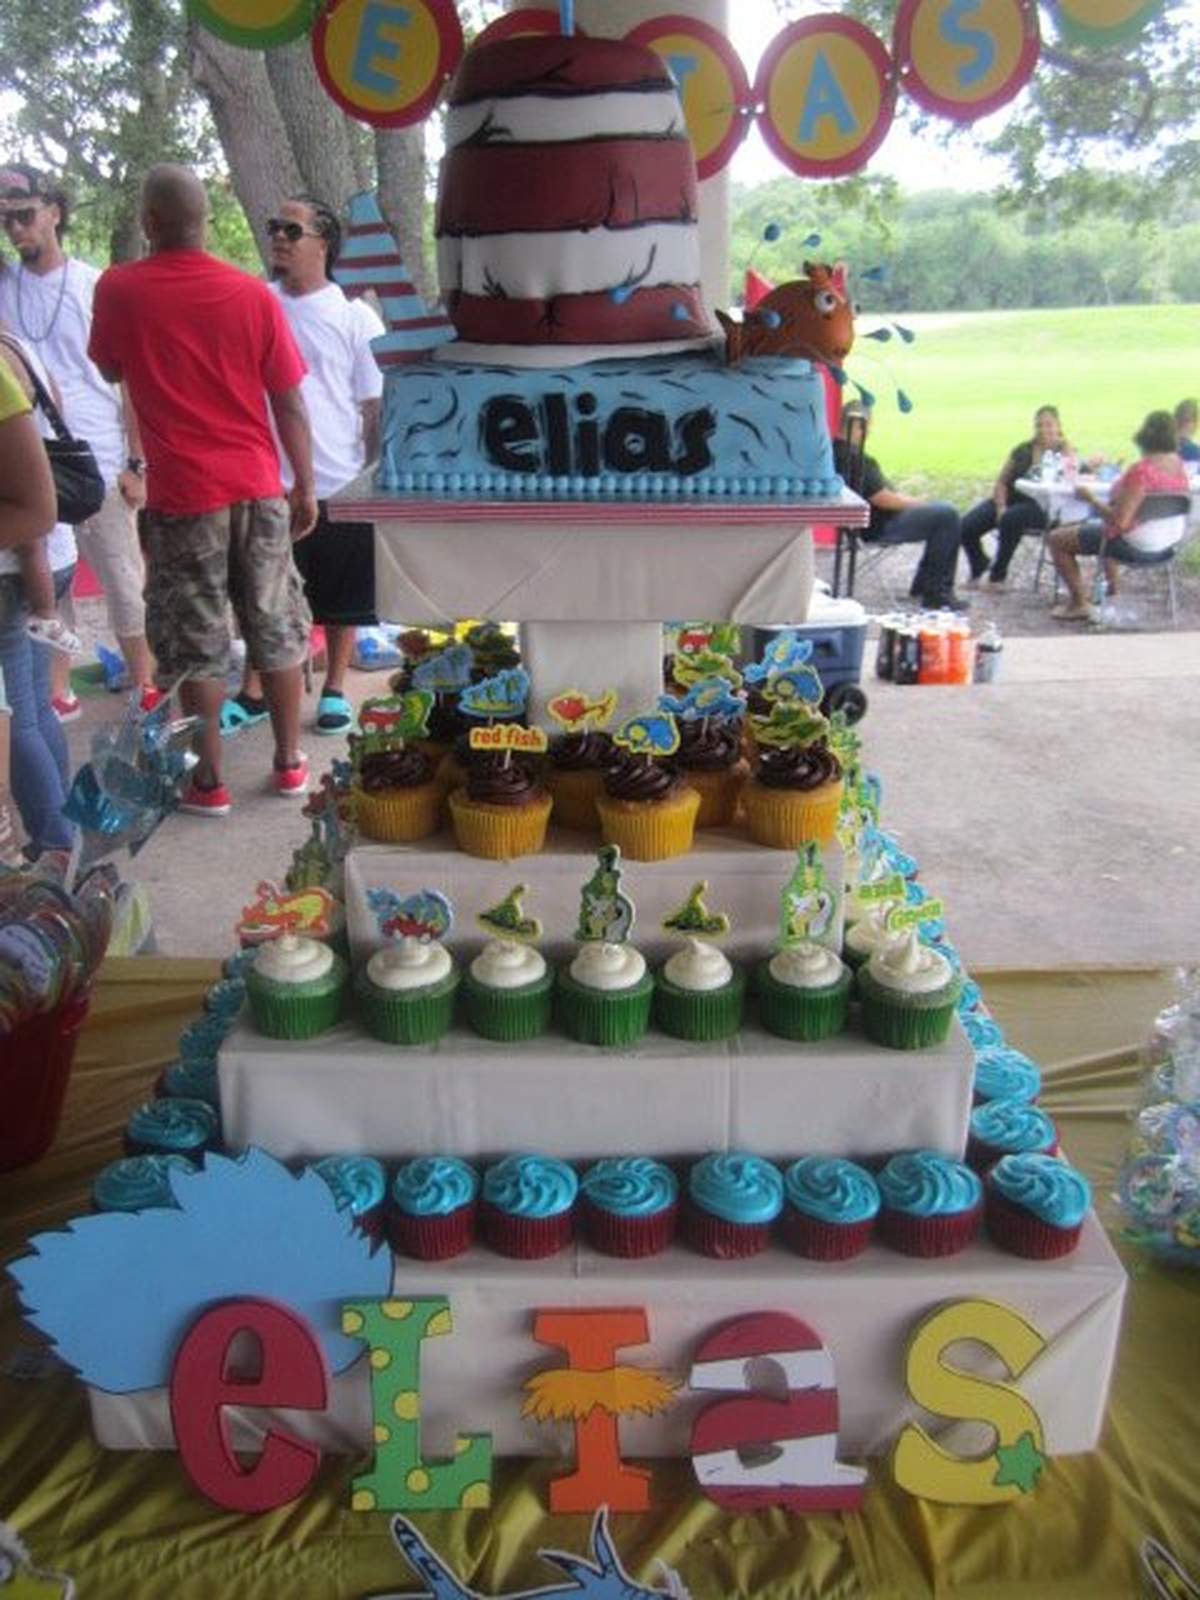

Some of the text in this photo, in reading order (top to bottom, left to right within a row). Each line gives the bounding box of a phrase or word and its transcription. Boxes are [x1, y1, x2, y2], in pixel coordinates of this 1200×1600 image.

[479, 391, 717, 476] elias
[473, 727, 542, 747] red fish
